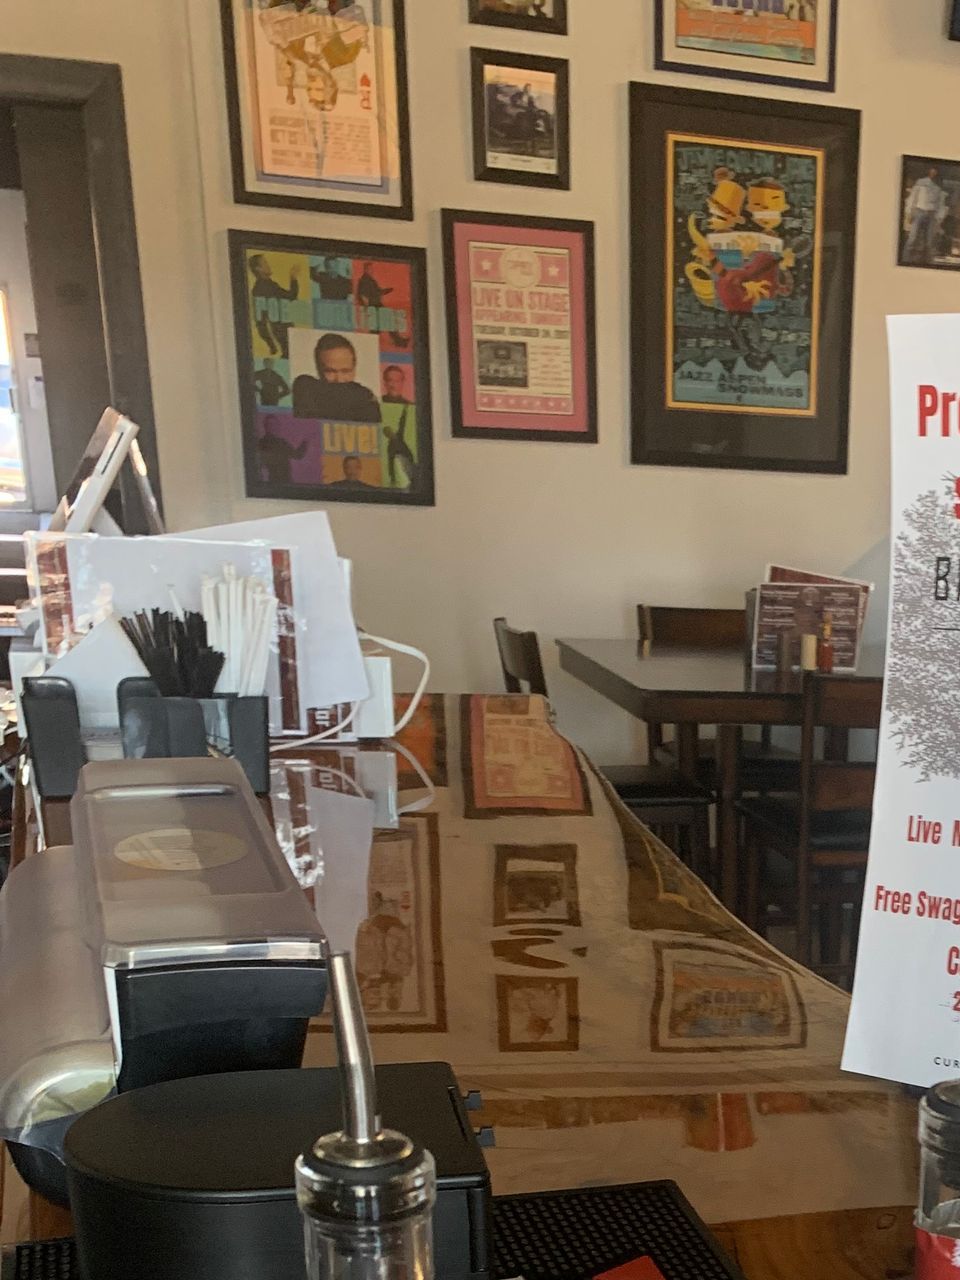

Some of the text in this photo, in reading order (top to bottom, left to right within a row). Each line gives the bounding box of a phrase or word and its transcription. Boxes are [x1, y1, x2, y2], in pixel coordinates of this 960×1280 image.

[474, 288, 569, 312] LIVE ON STAGE
[907, 815, 941, 845] Live
[874, 885, 911, 916] Free
